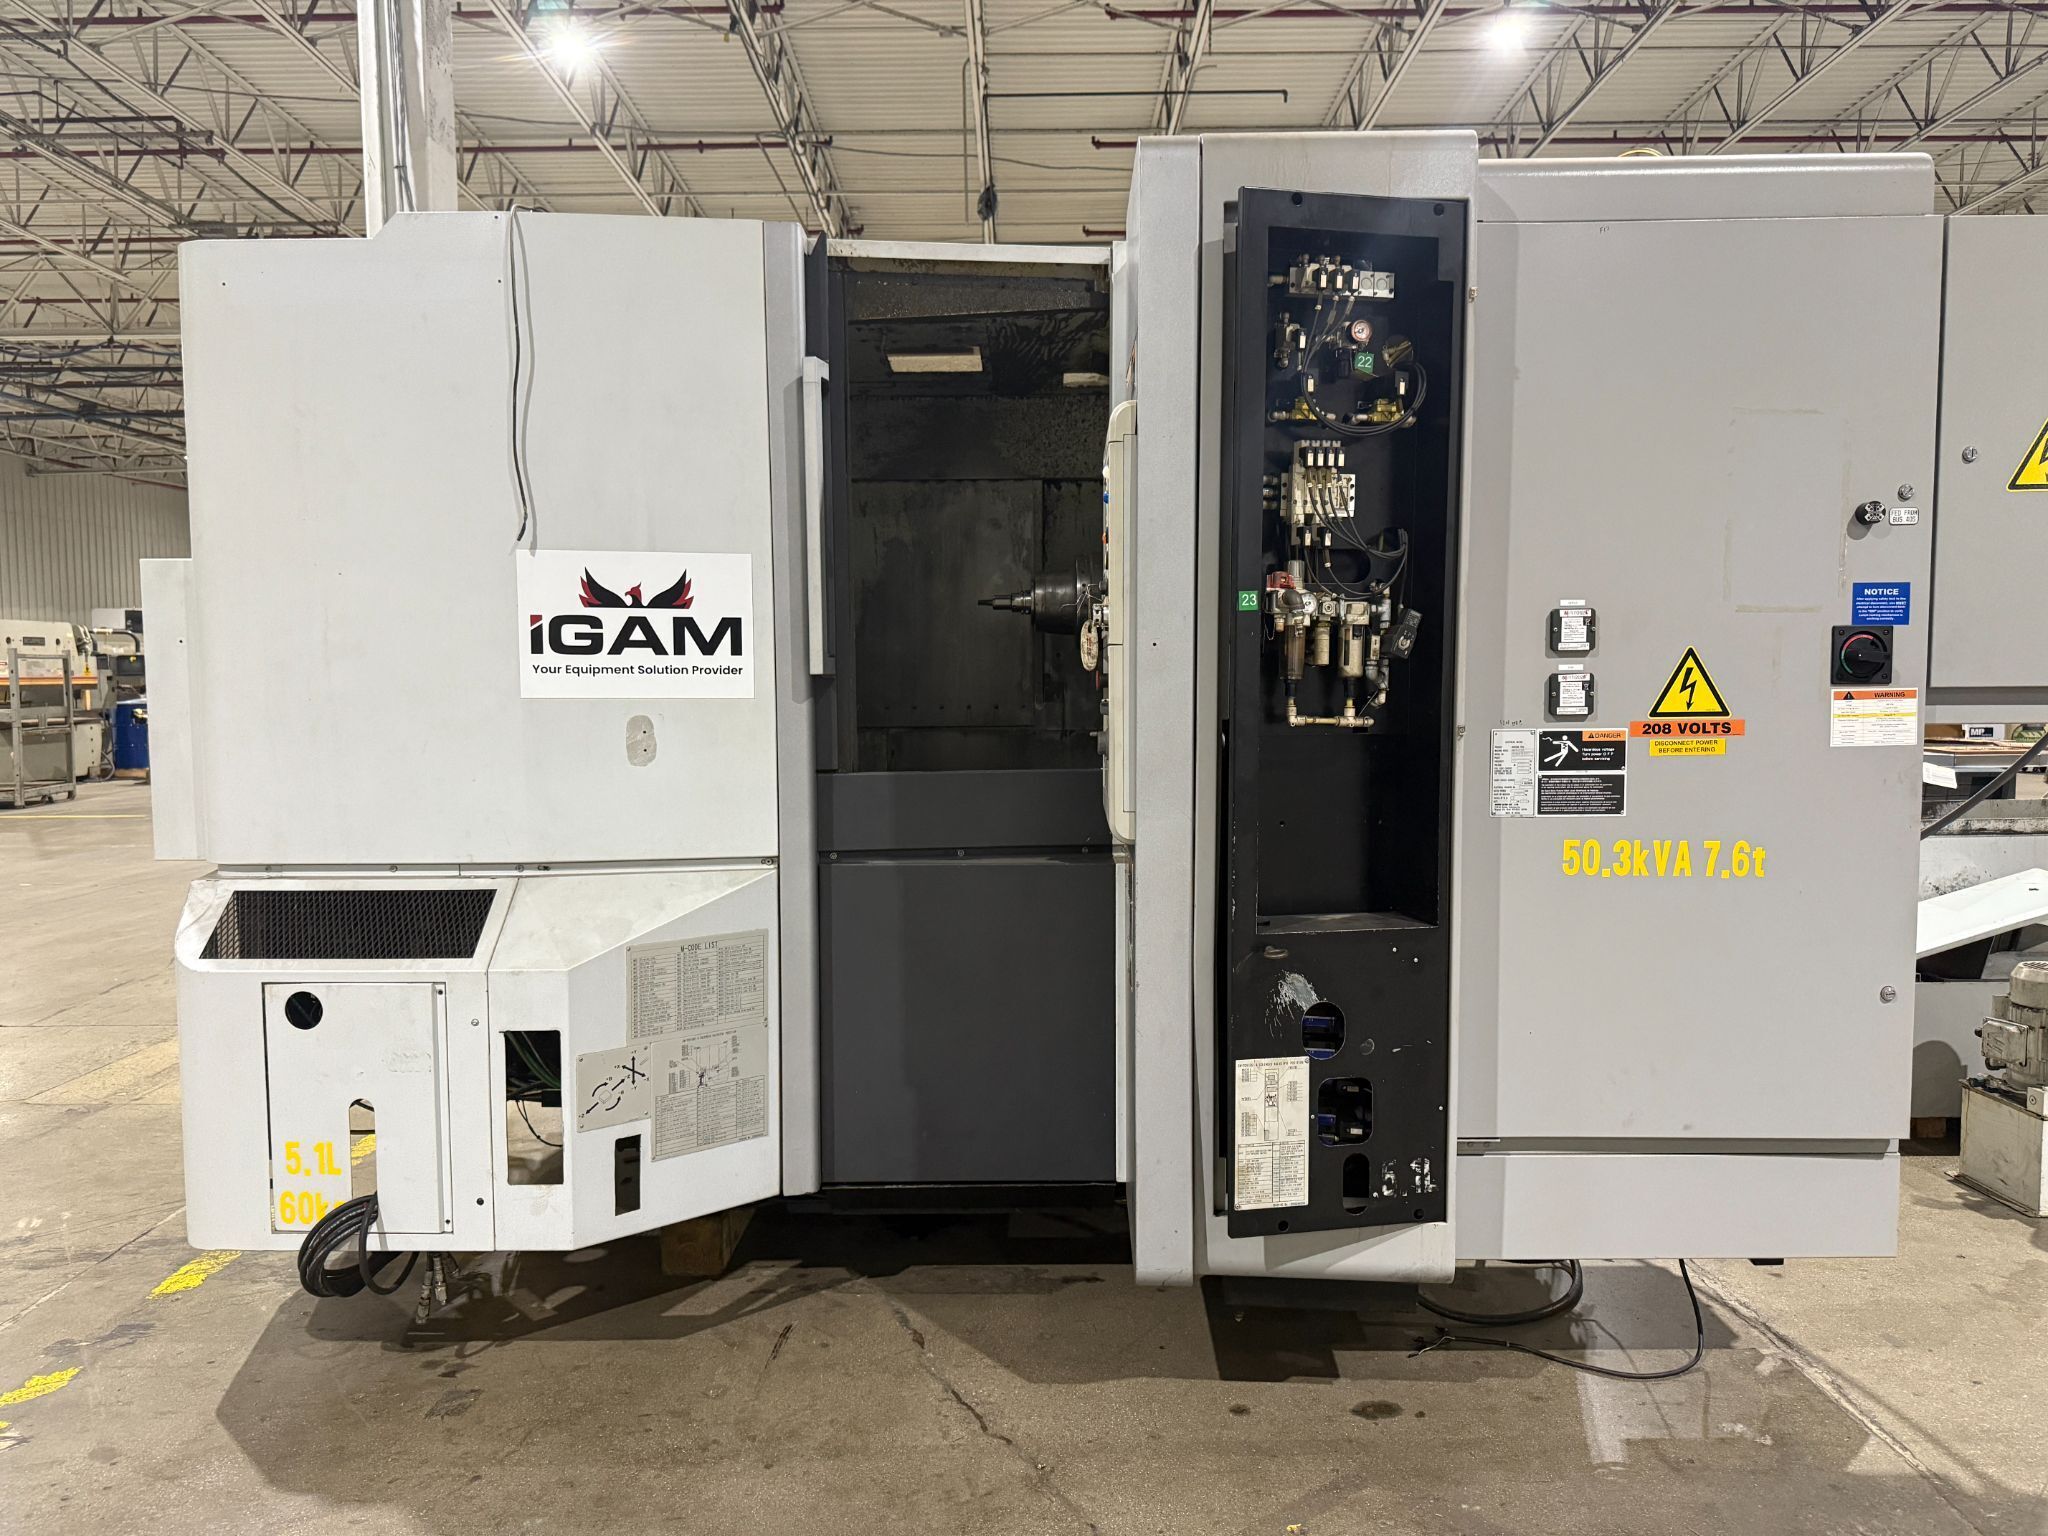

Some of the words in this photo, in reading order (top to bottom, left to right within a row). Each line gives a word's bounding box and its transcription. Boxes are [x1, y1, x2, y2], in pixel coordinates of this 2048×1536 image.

[1357, 355, 1372, 368] 22
[1864, 588, 1900, 596] NOTICE
[1241, 593, 1257, 606] 23
[532, 664, 561, 675] Your
[565, 664, 635, 677] Equipment
[637, 664, 689, 675] Solution
[692, 665, 743, 676] Provider
[1642, 723, 1672, 735] 208
[1677, 722, 1732, 734] VOLTS
[1970, 728, 1985, 736] MP
[1562, 838, 1693, 878] 50.3kVA
[1703, 840, 1766, 879] 7.6t
[680, 942, 701, 952] M-CODE
[704, 940, 718, 950] LIST
[285, 1141, 343, 1177] 5.1L
[279, 1190, 347, 1225] 60k
